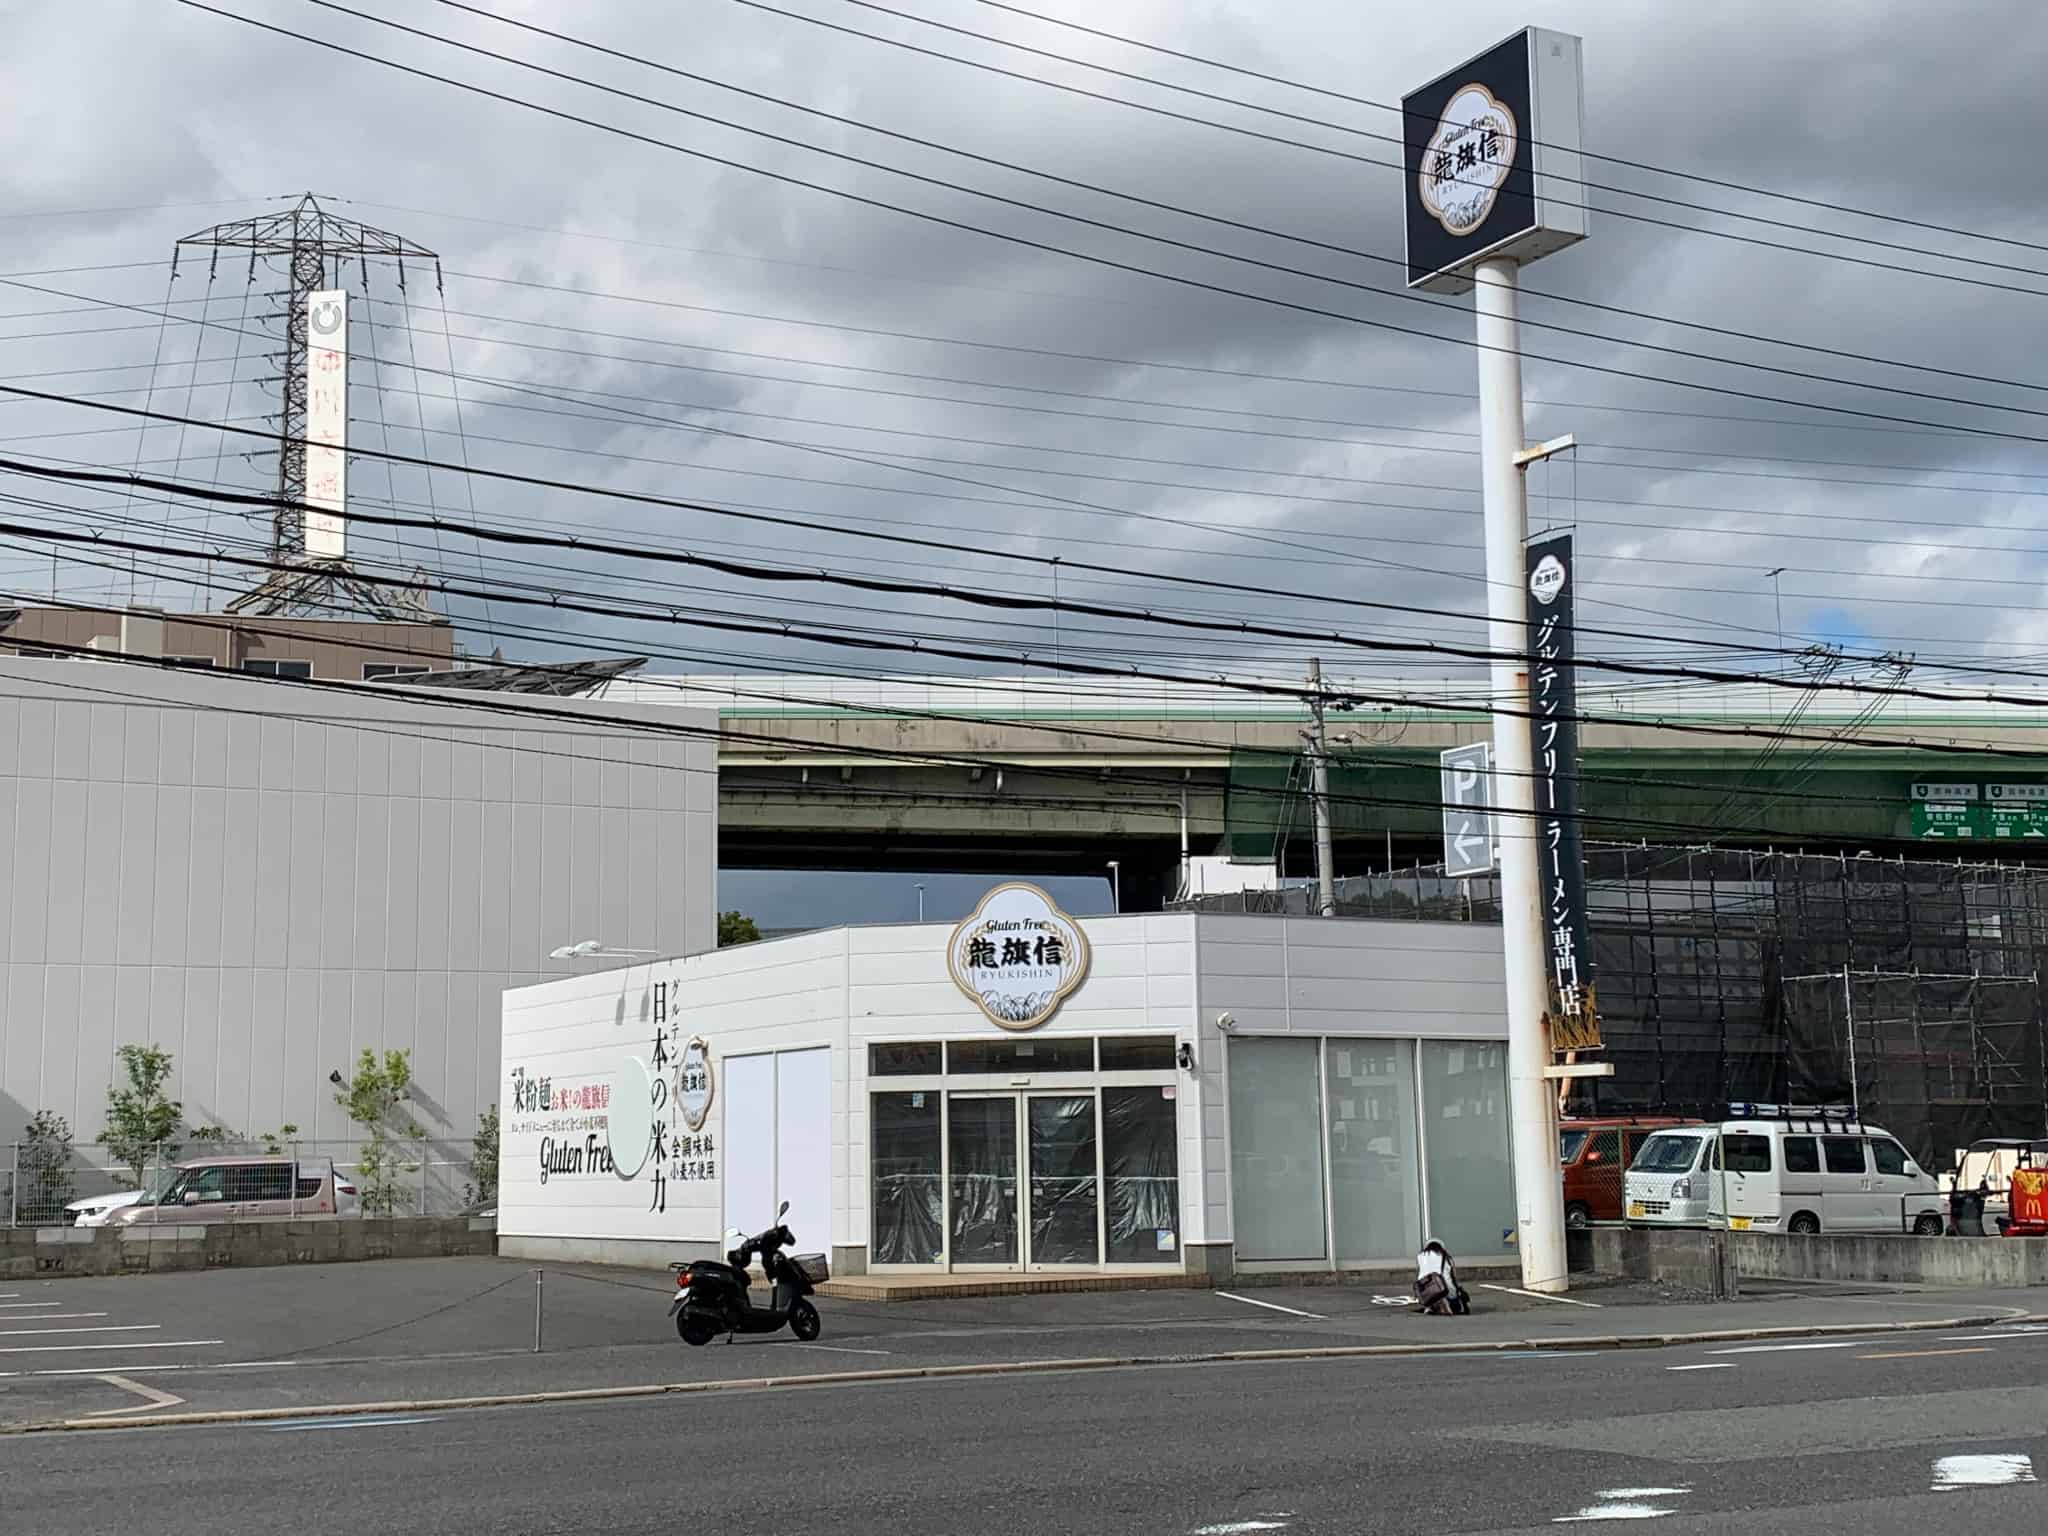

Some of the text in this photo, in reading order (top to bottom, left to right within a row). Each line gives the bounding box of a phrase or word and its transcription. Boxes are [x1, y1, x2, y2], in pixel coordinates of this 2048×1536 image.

[1453, 759, 1478, 805] P
[1536, 614, 1582, 1017] グルテンフリー ラーメン専門店
[986, 919, 1021, 934] Gluten
[969, 935, 1064, 969] 龍旗信
[981, 968, 1053, 979] RYUKISHIN
[649, 981, 668, 1214] 日本の米力
[540, 1136, 582, 1185] Gluten
[670, 1161, 715, 1180] 小麦不使用
